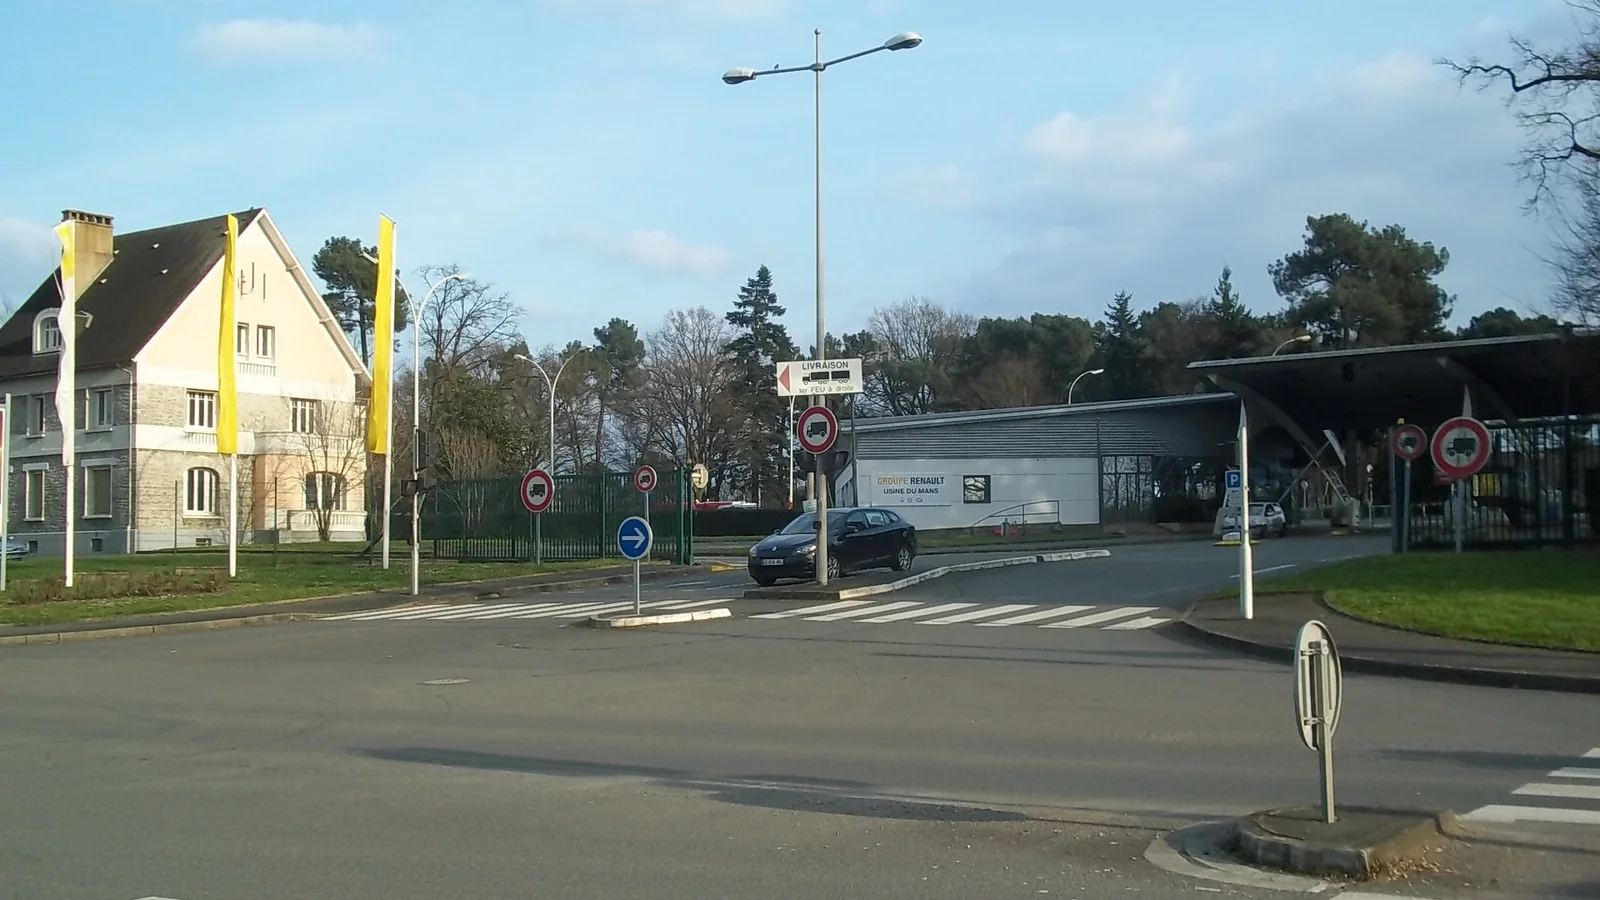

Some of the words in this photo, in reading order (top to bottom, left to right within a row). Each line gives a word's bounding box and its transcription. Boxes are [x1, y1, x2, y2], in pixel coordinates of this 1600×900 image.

[802, 361, 849, 370] LIVRAISON
[877, 477, 908, 485] GROUPE
[910, 476, 945, 485] RENAULT
[1230, 474, 1239, 485] P
